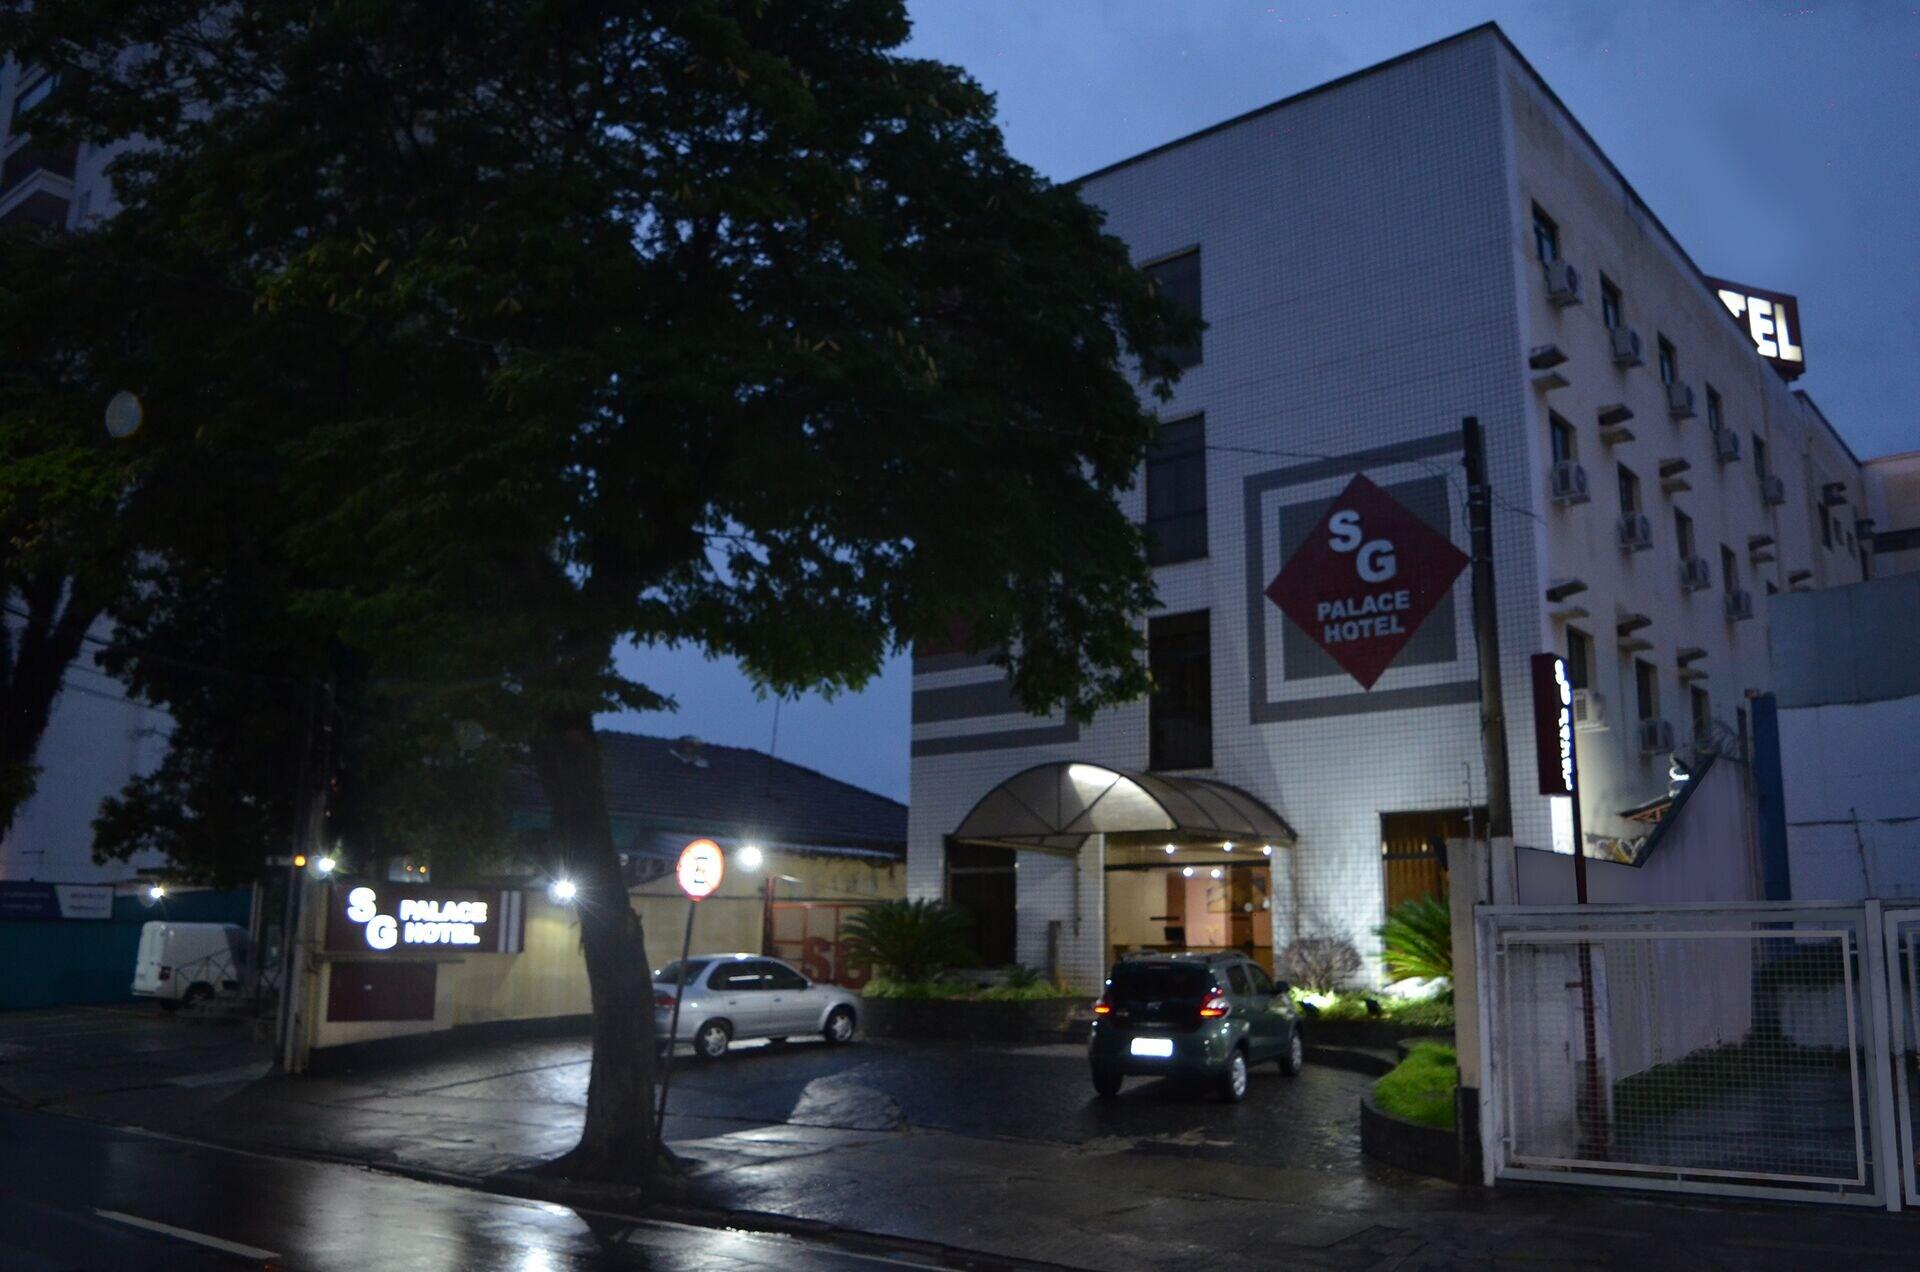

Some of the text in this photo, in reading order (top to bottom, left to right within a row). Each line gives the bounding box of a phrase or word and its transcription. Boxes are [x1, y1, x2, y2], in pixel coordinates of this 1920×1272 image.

[1316, 589, 1411, 622] PALACE
[1323, 613, 1408, 644] HOTEL
[400, 899, 488, 924] PALACE
[404, 921, 481, 945] HOTEL
